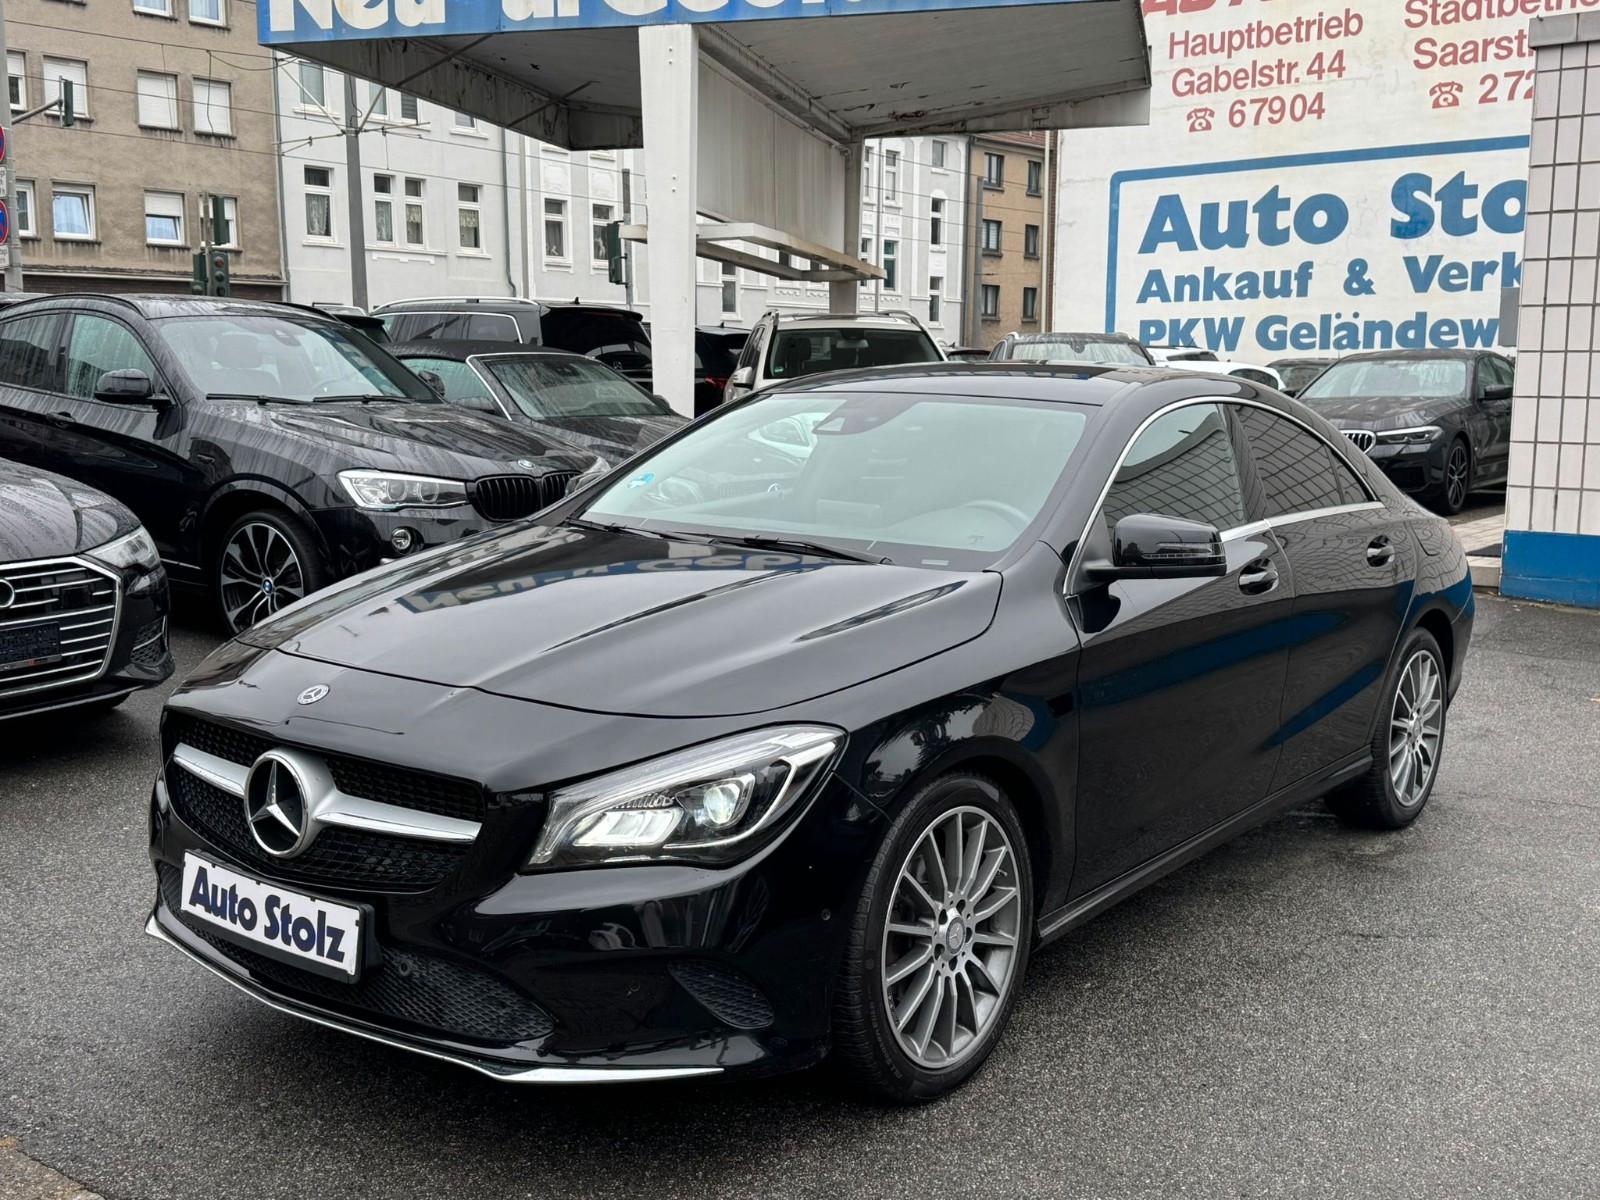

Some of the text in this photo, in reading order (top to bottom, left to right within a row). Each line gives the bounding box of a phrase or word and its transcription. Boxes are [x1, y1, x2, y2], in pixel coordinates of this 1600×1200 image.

[1168, 8, 1364, 60] Hauptbetrieb
[1412, 29, 1535, 70] Saarst
[1171, 49, 1346, 98] Gabelstr. 44
[1227, 92, 1326, 129] 67904
[1137, 184, 1349, 255] Auto
[1135, 260, 1314, 304] Ankauf
[1343, 257, 1376, 297] &
[1139, 316, 1245, 352] PKW
[188, 864, 346, 964] Auto Stolz
